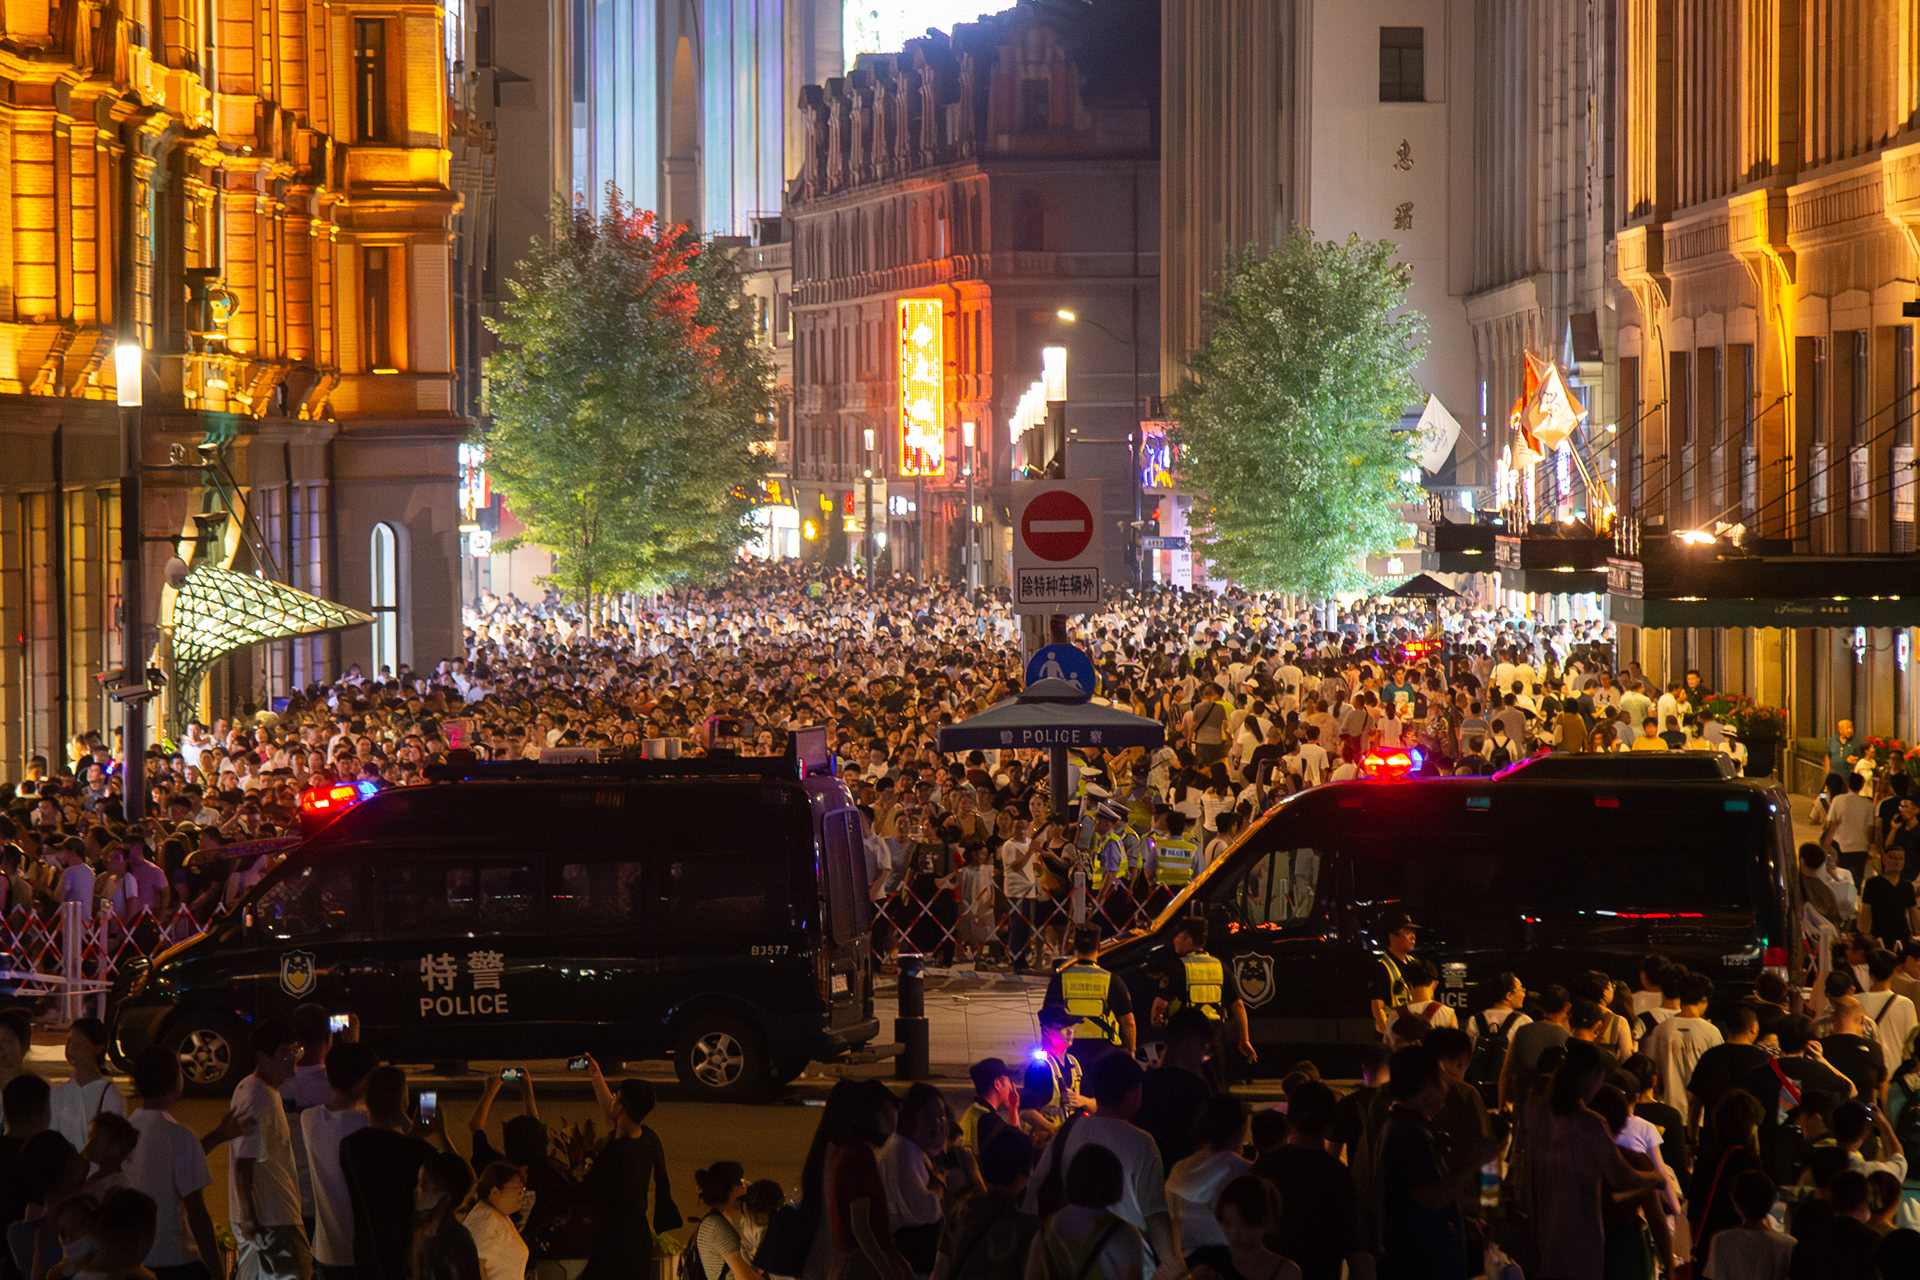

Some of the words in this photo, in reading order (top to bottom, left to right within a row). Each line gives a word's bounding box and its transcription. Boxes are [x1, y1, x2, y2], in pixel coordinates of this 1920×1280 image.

[1021, 574, 1095, 598] 除特种车辆外
[1022, 729, 1081, 743] POLICE
[751, 945, 790, 956] B3577
[420, 950, 505, 992] 特警
[1441, 962, 1468, 989] 警
[420, 993, 510, 1018] POLICE
[1440, 992, 1468, 1008] ICE
